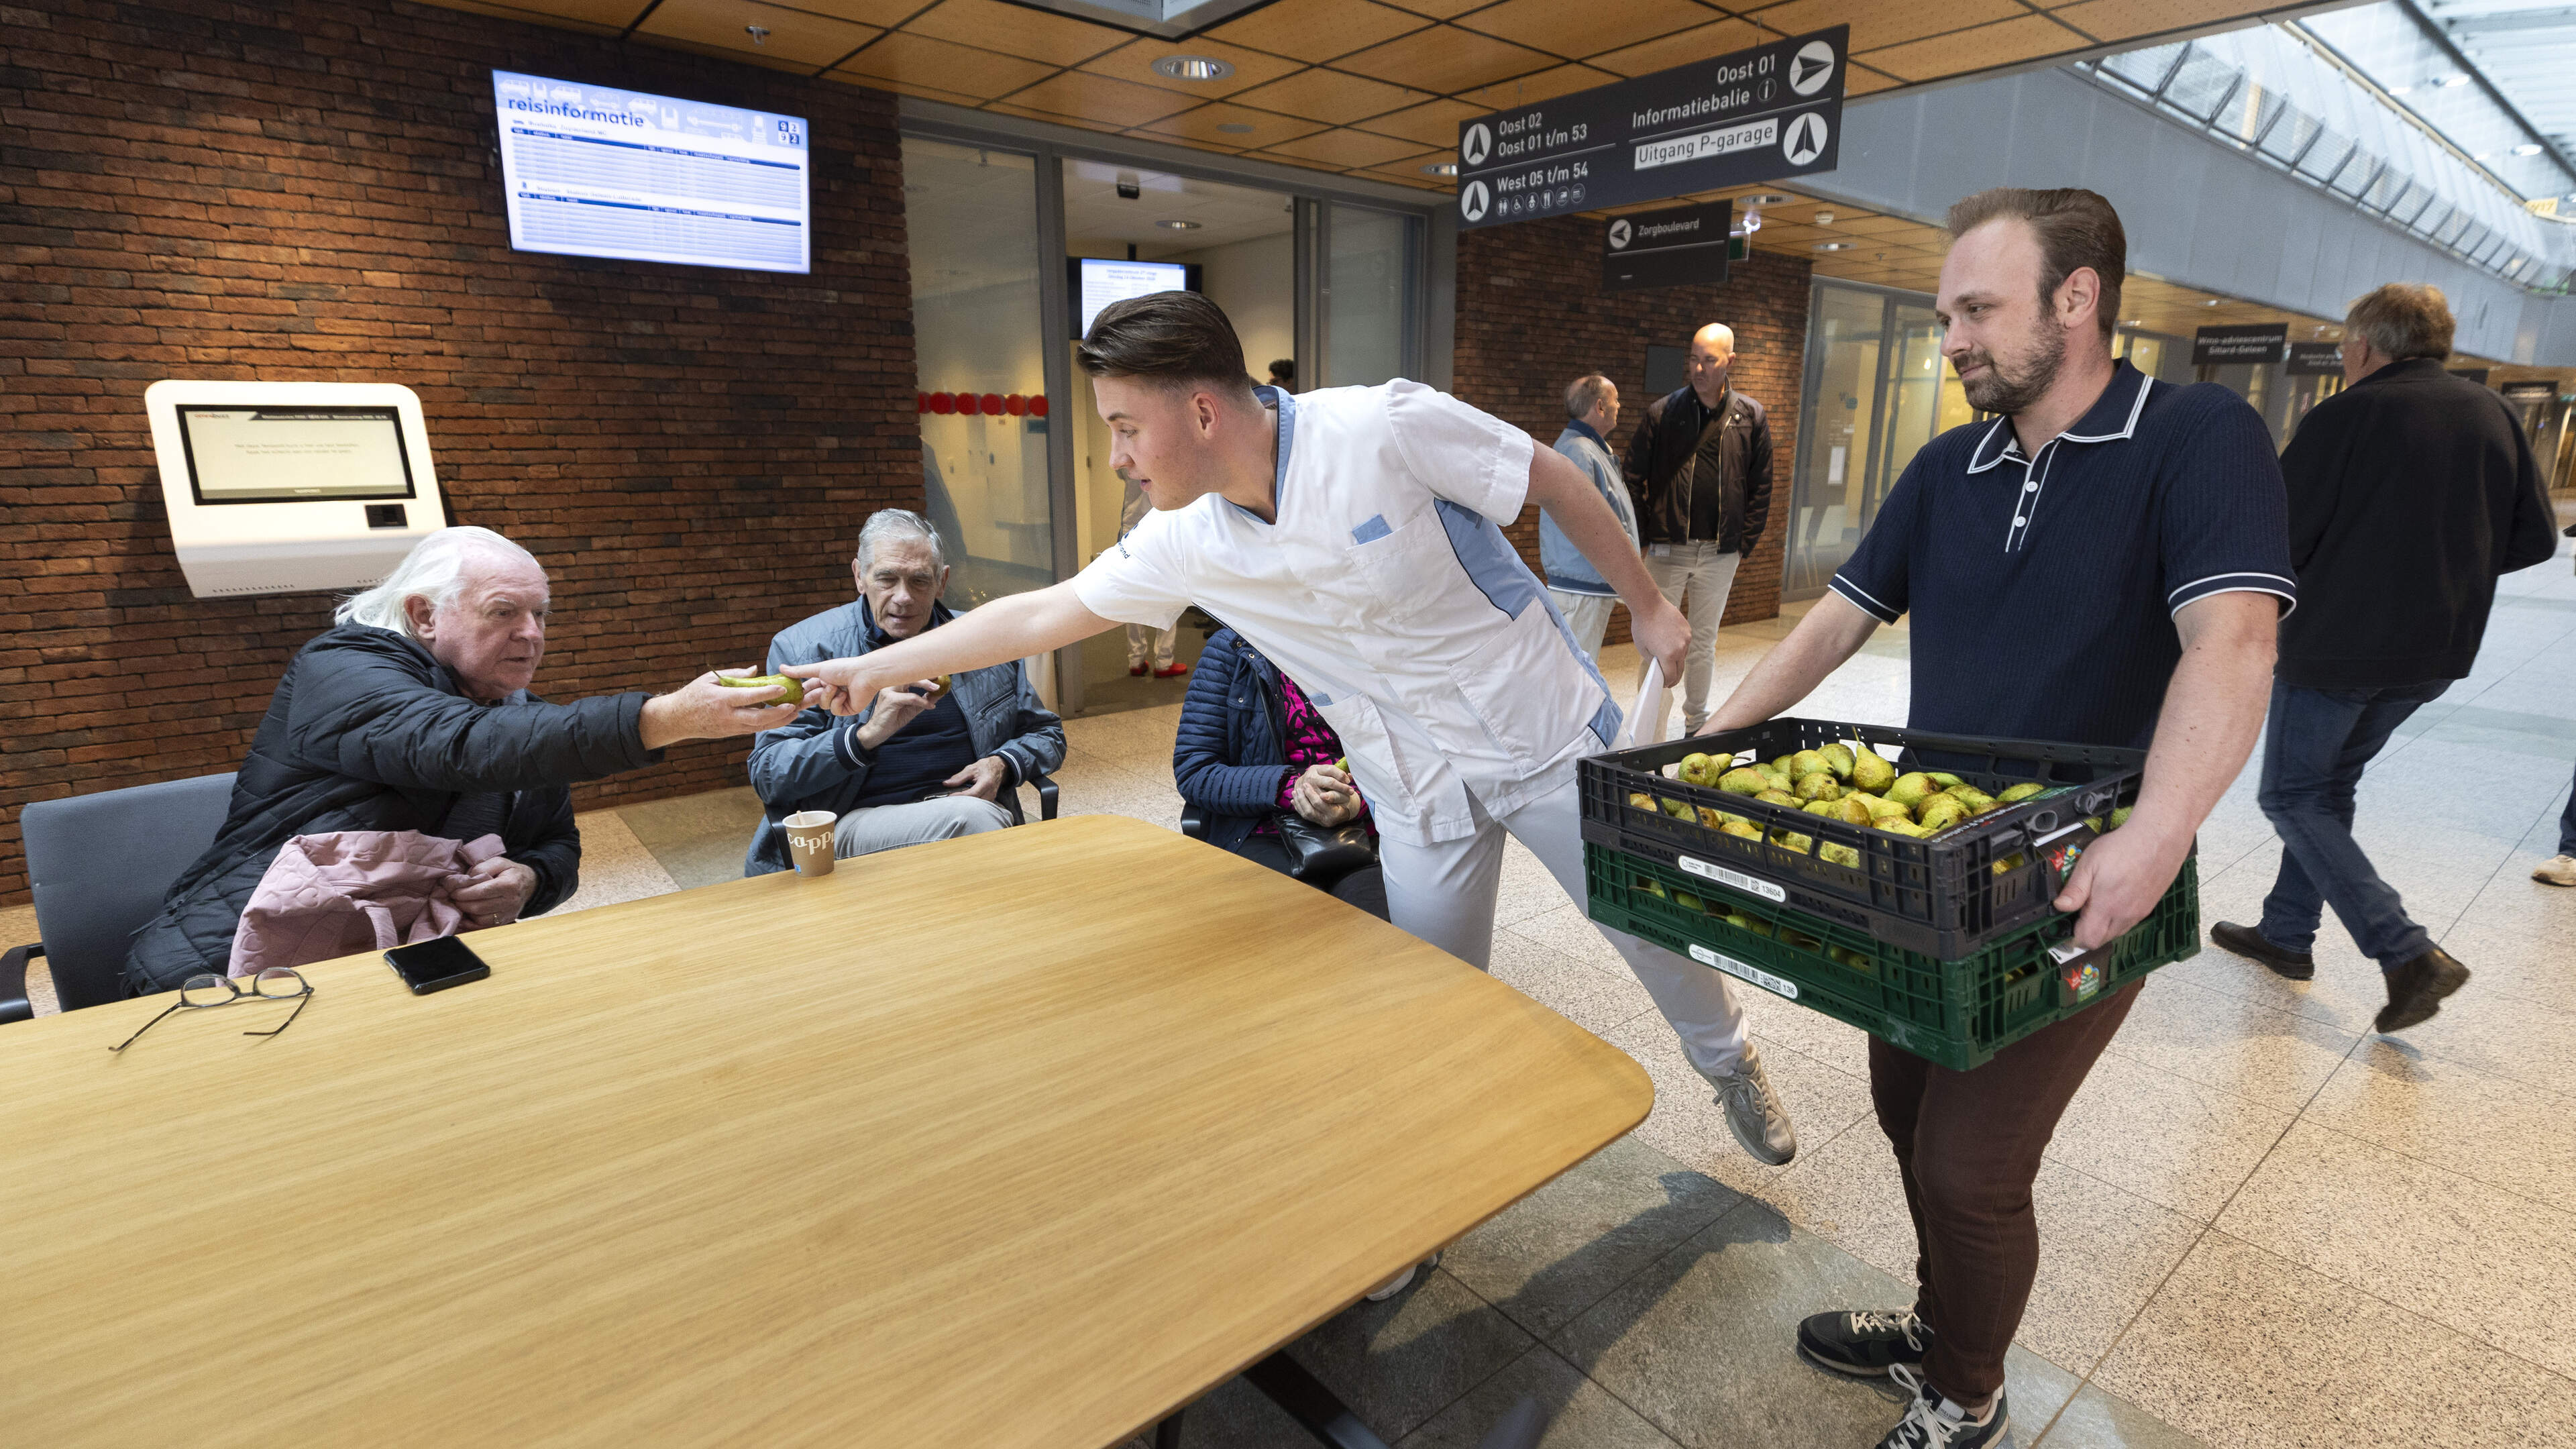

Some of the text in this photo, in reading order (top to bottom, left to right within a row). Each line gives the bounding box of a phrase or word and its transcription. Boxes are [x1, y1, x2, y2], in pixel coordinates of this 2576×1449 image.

[1717, 54, 1776, 85] Oost 01
[508, 97, 644, 127] reisinformatie
[1631, 88, 1750, 128] Informatiebalie
[1498, 123, 1587, 156] Oost 01 t/m 53
[1499, 112, 1542, 136] Oost 02
[1639, 126, 1773, 163] Uitgang P-garage
[1497, 161, 1589, 192] West 05 t/m 54
[1638, 218, 1699, 237] Zorgboulevard
